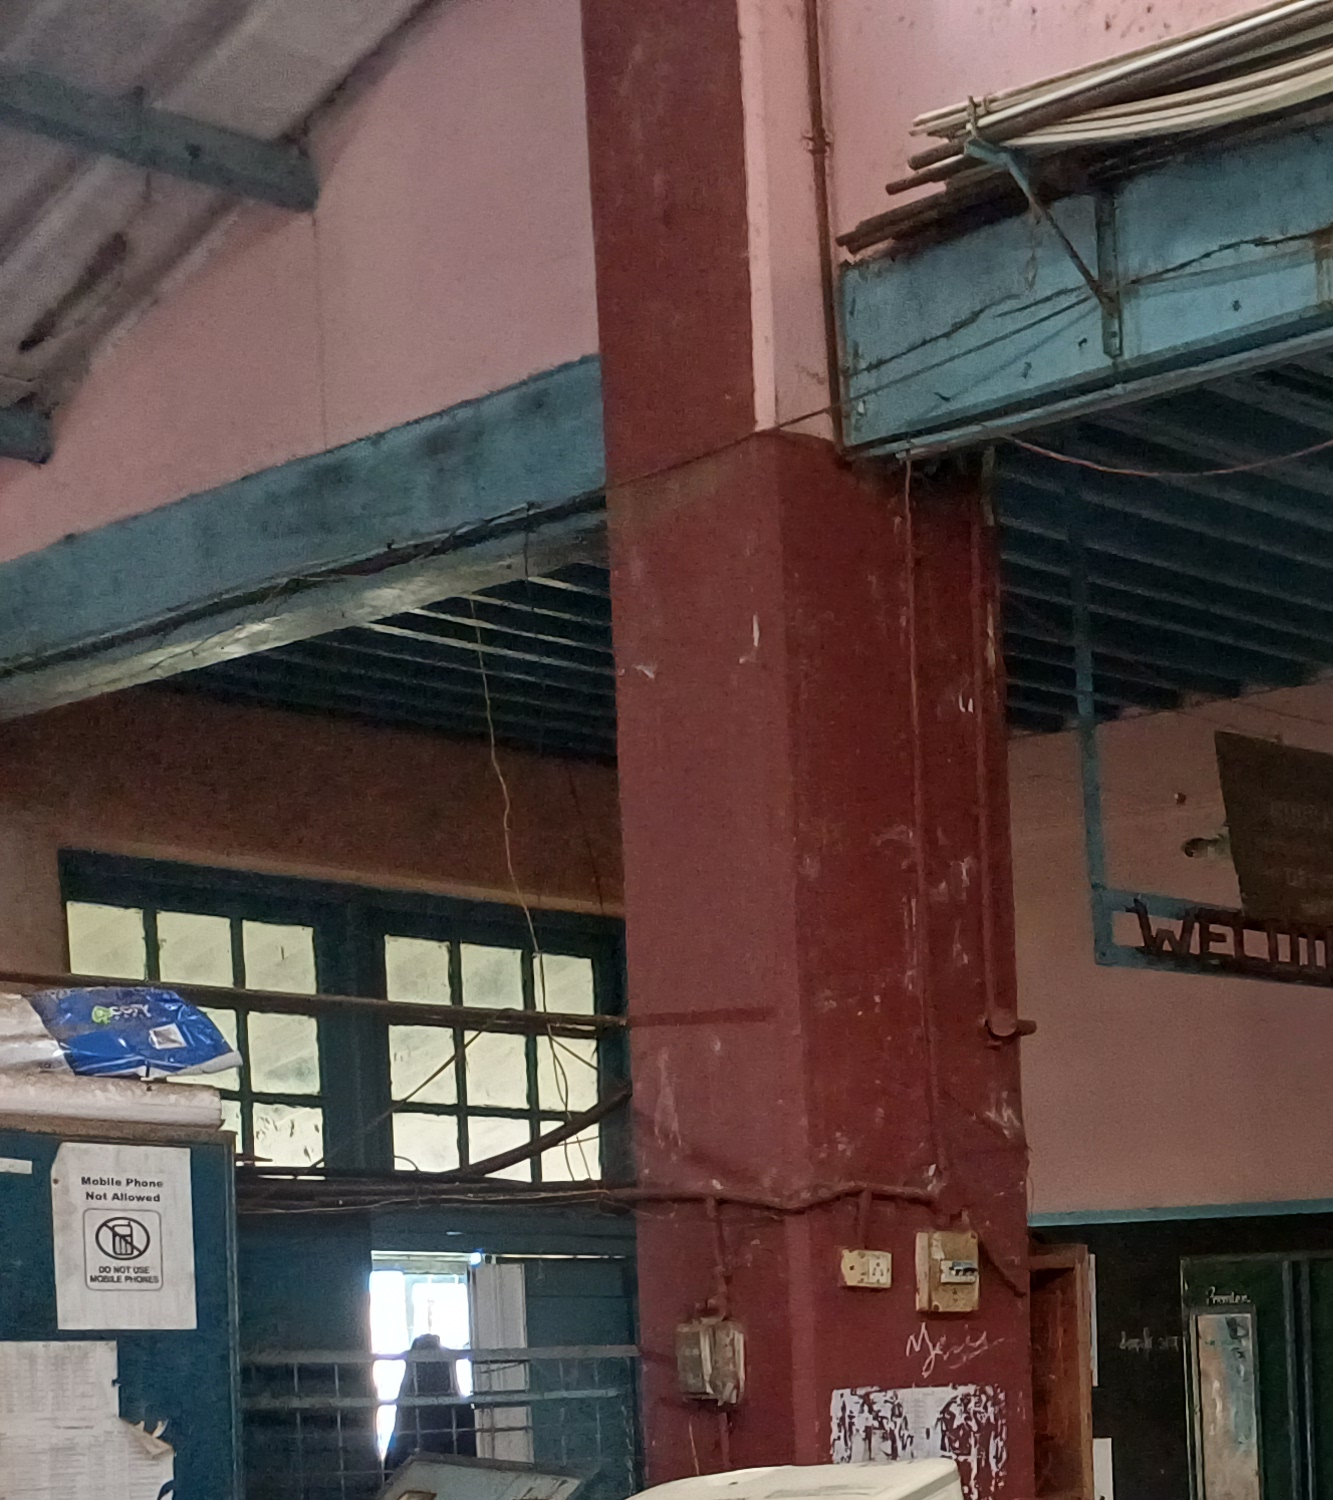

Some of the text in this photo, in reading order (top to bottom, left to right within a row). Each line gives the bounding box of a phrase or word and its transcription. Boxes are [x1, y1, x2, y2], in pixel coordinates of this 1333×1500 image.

[81, 1176, 164, 1188] Mobile Phone
[85, 1191, 161, 1202] Not Allowed
[99, 1266, 150, 1274] DO NOT USE
[90, 1275, 159, 1283] MOBILE PHONES
